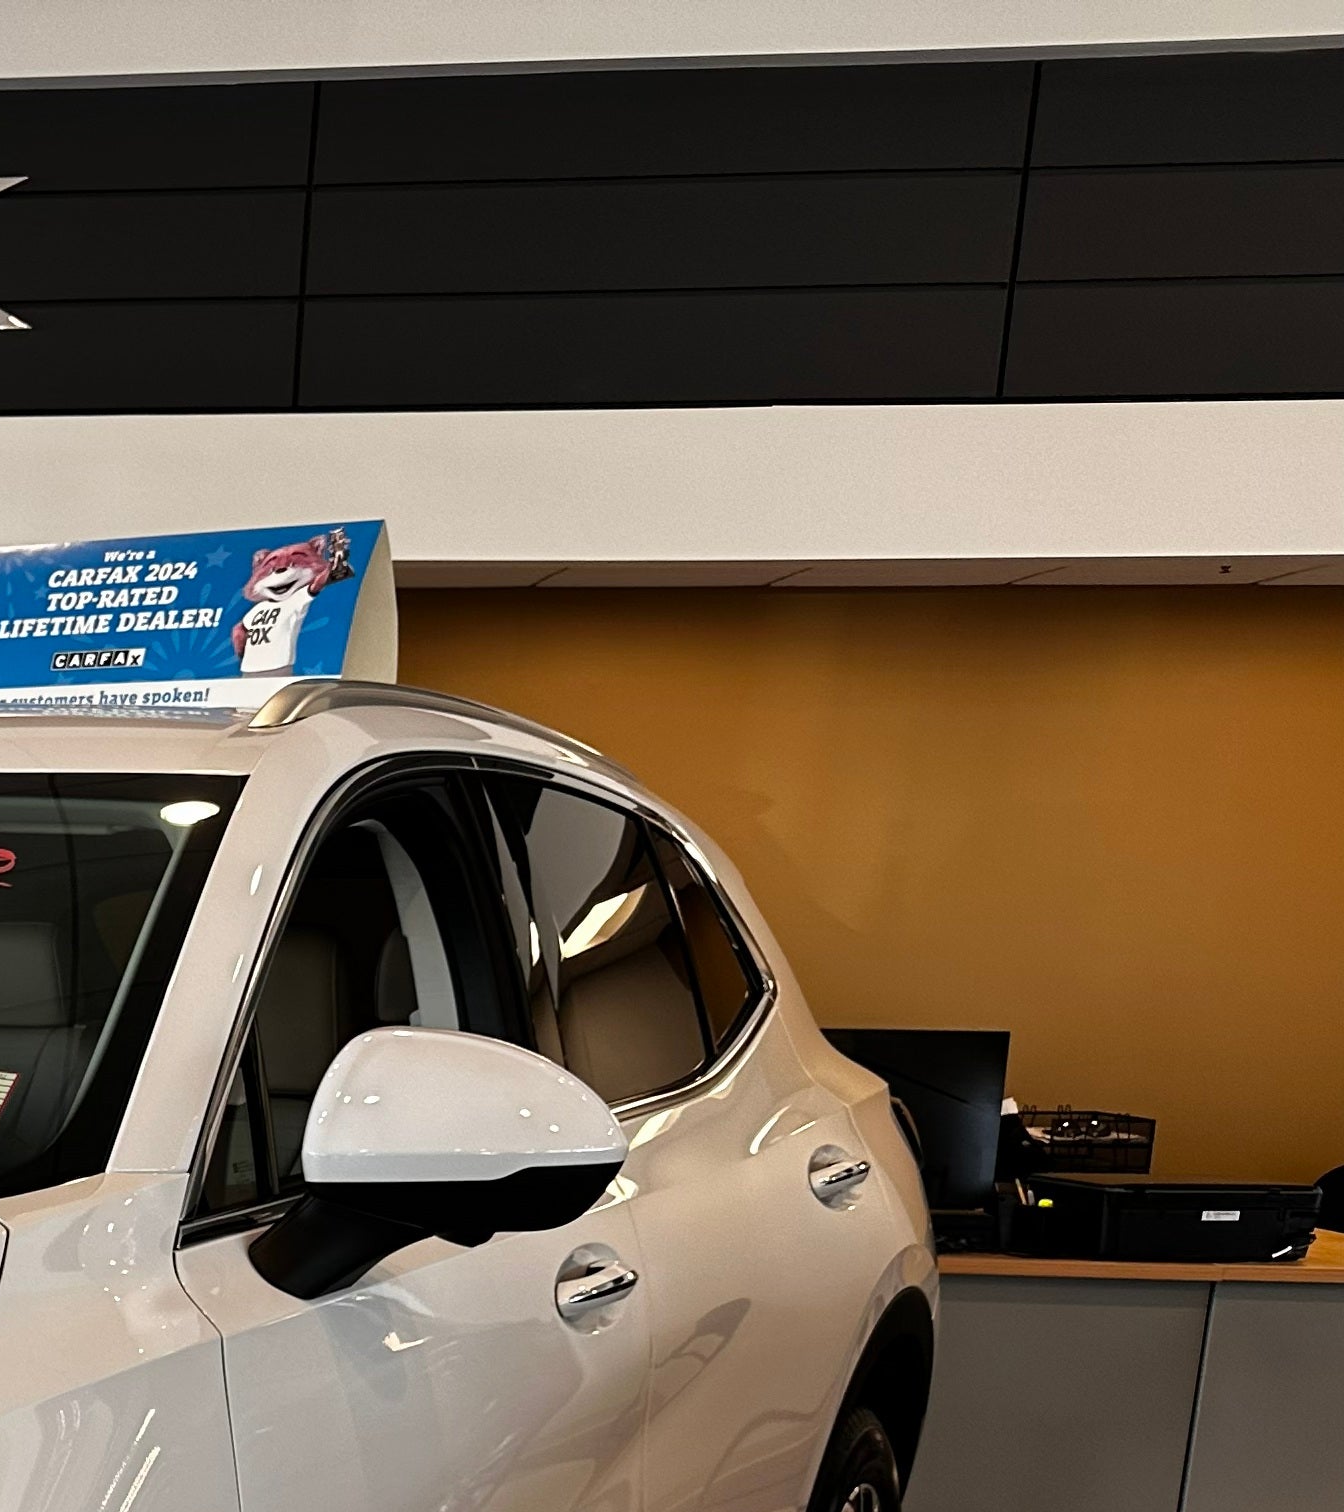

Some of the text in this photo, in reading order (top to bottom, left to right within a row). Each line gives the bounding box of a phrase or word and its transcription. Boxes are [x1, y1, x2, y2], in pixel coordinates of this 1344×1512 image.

[104, 550, 156, 562] We're a
[48, 561, 198, 588] CARFAX 2024
[46, 586, 179, 612] TOP-RATED
[115, 607, 223, 632] DEALER!
[251, 607, 281, 626] CAR
[54, 650, 142, 669] CARFAX
[100, 691, 138, 705] have
[142, 688, 210, 705] spoken!
